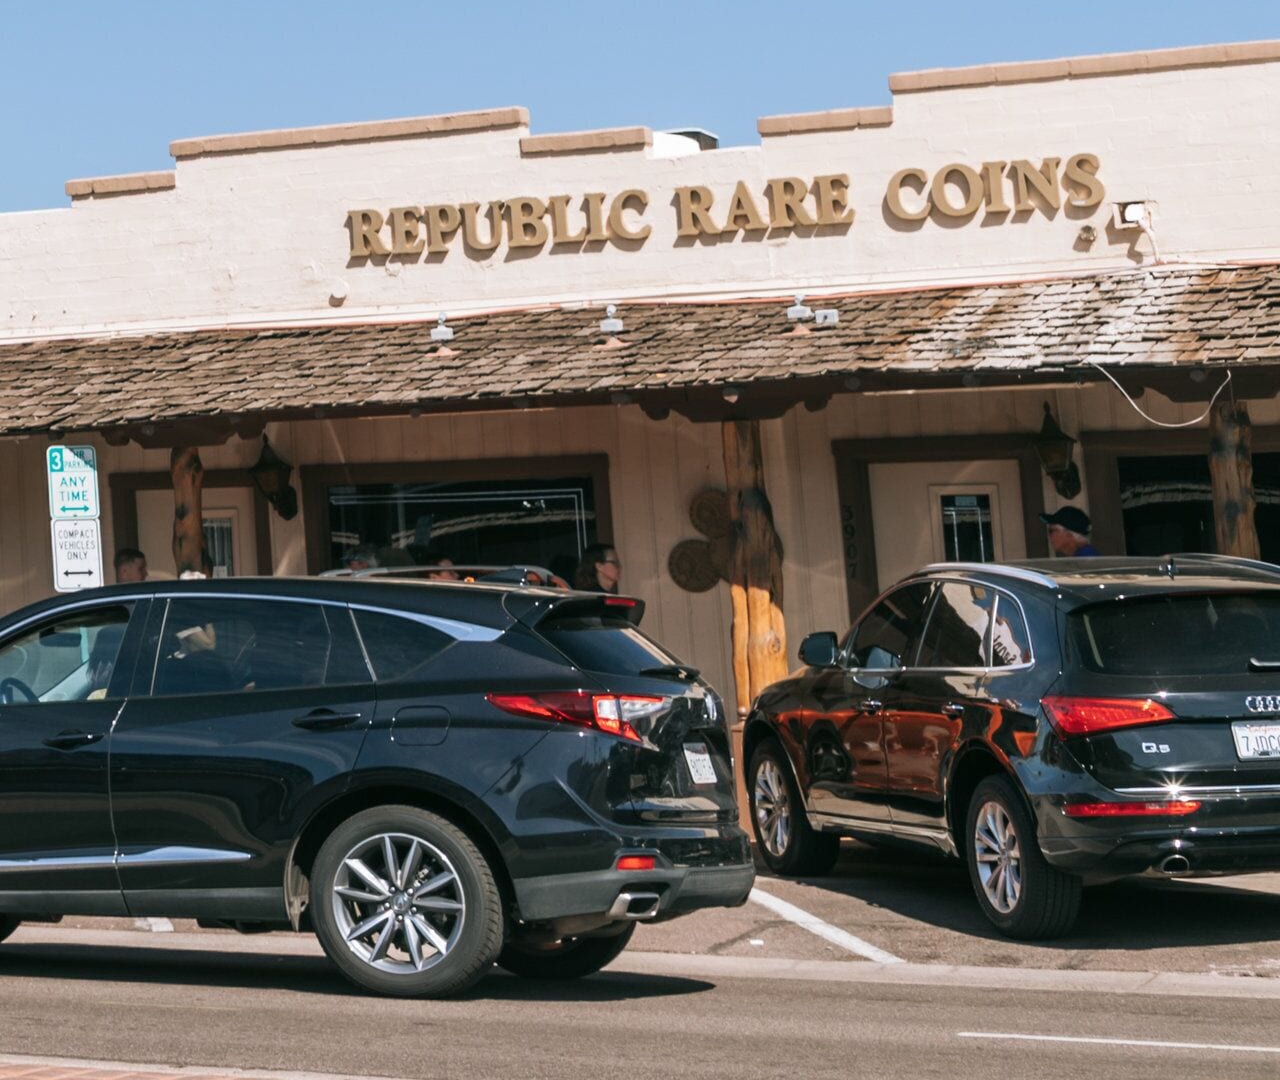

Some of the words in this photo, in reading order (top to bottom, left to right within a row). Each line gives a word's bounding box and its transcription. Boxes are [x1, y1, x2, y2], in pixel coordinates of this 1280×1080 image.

[346, 188, 651, 257] REPUBLIC
[675, 173, 855, 236] RARE
[886, 152, 1106, 222] COINS
[51, 451, 61, 470] 3
[60, 476, 87, 487] ANY
[59, 490, 88, 502] TIME
[58, 529, 95, 540] COMPACT
[58, 540, 96, 550] VEHICLES
[67, 551, 88, 561] ONLY
[1241, 735, 1280, 754] 7JDC
